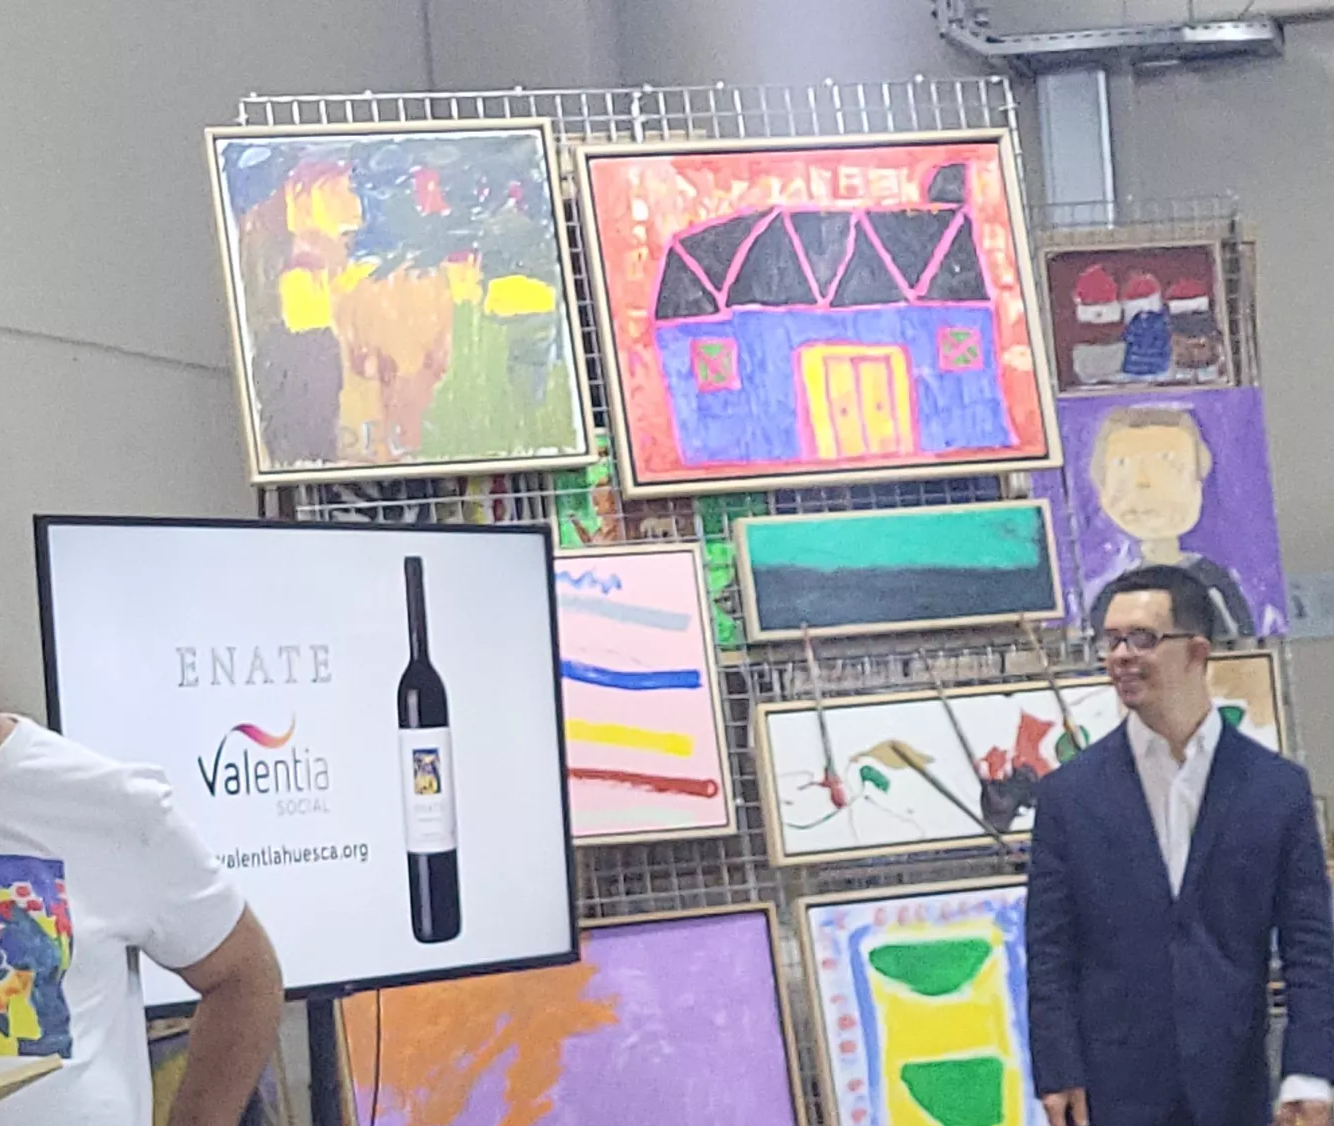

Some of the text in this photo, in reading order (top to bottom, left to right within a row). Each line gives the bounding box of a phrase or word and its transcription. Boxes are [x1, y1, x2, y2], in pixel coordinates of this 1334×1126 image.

[176, 645, 332, 687] ENATE
[198, 733, 330, 796] Valentia
[277, 797, 331, 816] SOCIAL
